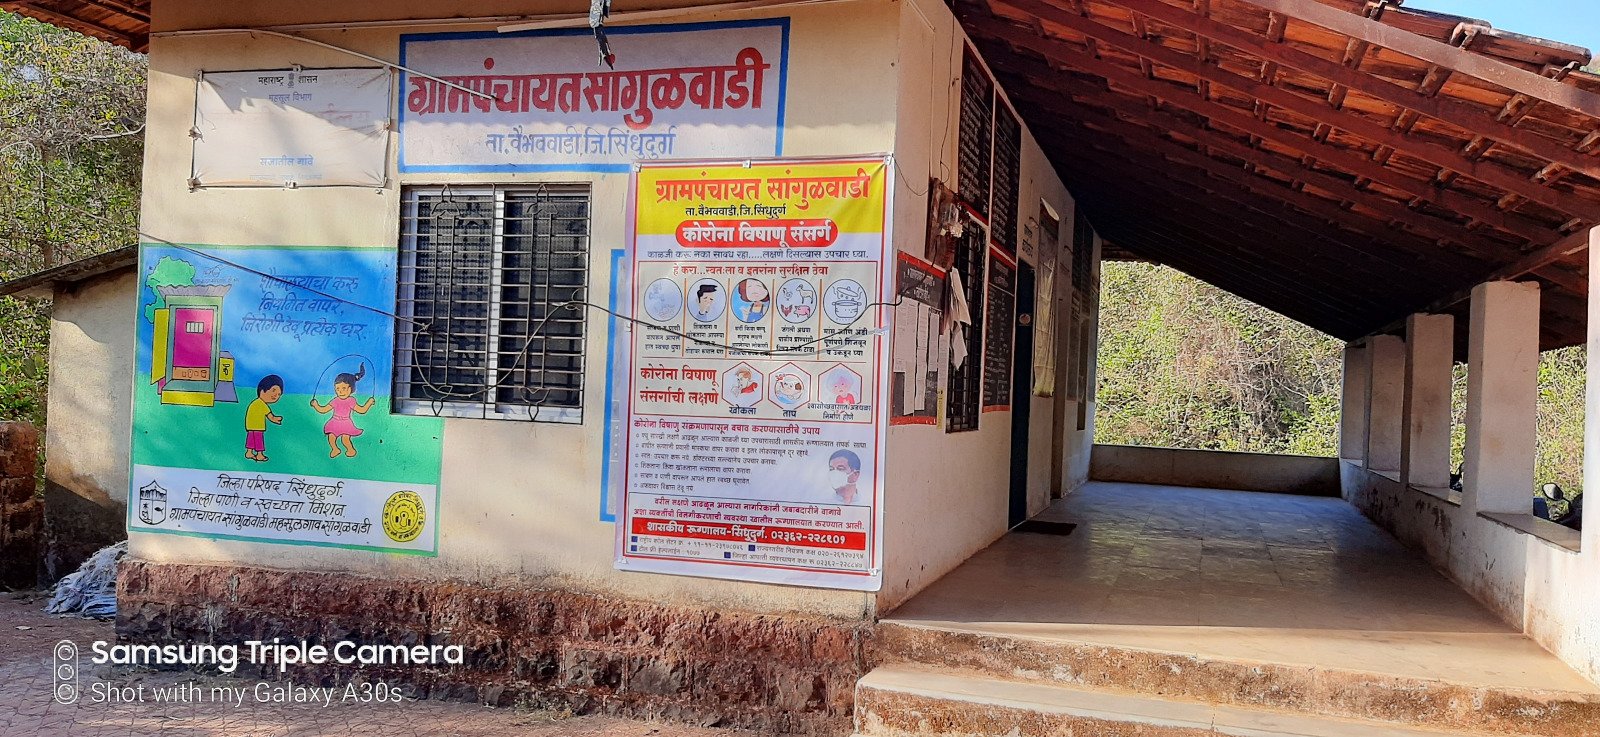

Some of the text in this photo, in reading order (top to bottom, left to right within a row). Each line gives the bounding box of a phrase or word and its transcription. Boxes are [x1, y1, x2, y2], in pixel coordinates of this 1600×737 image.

[258, 75, 318, 87] महाराष्ट्र शासन
[407, 47, 771, 129] ग्रामपंचायत सांगुळवाडी
[293, 91, 312, 101] विभाग
[655, 168, 871, 210] ग्रामपंचायत सांगुळवाडी
[682, 219, 832, 246] कोरोना विषाणू संसर्ग
[647, 249, 673, 259] काळजी
[694, 250, 711, 259] नका
[786, 249, 821, 258] दिसल्यास
[824, 250, 850, 259] उपचार
[673, 263, 679, 276] हे
[738, 266, 744, 275] व
[746, 263, 777, 276] इतरांना
[779, 263, 810, 279] सुरक्षित
[812, 263, 829, 275] ठेवा
[640, 363, 719, 387] कोरोना विषाणू
[640, 386, 719, 406] संसर्गाची लक्षणे
[729, 403, 756, 415] खोकला
[783, 409, 797, 418] ताप
[634, 418, 656, 428] कोरोना
[802, 427, 820, 435] उपाय
[217, 474, 247, 492] जिल्हा
[247, 474, 284, 496] परिषद
[188, 486, 216, 507] जिल्हा
[216, 492, 241, 507] पाणी
[241, 496, 256, 509] व
[254, 498, 305, 513] स्वच्छता
[170, 507, 224, 524] ग्रामपंचायत
[647, 520, 685, 534] शासकीय
